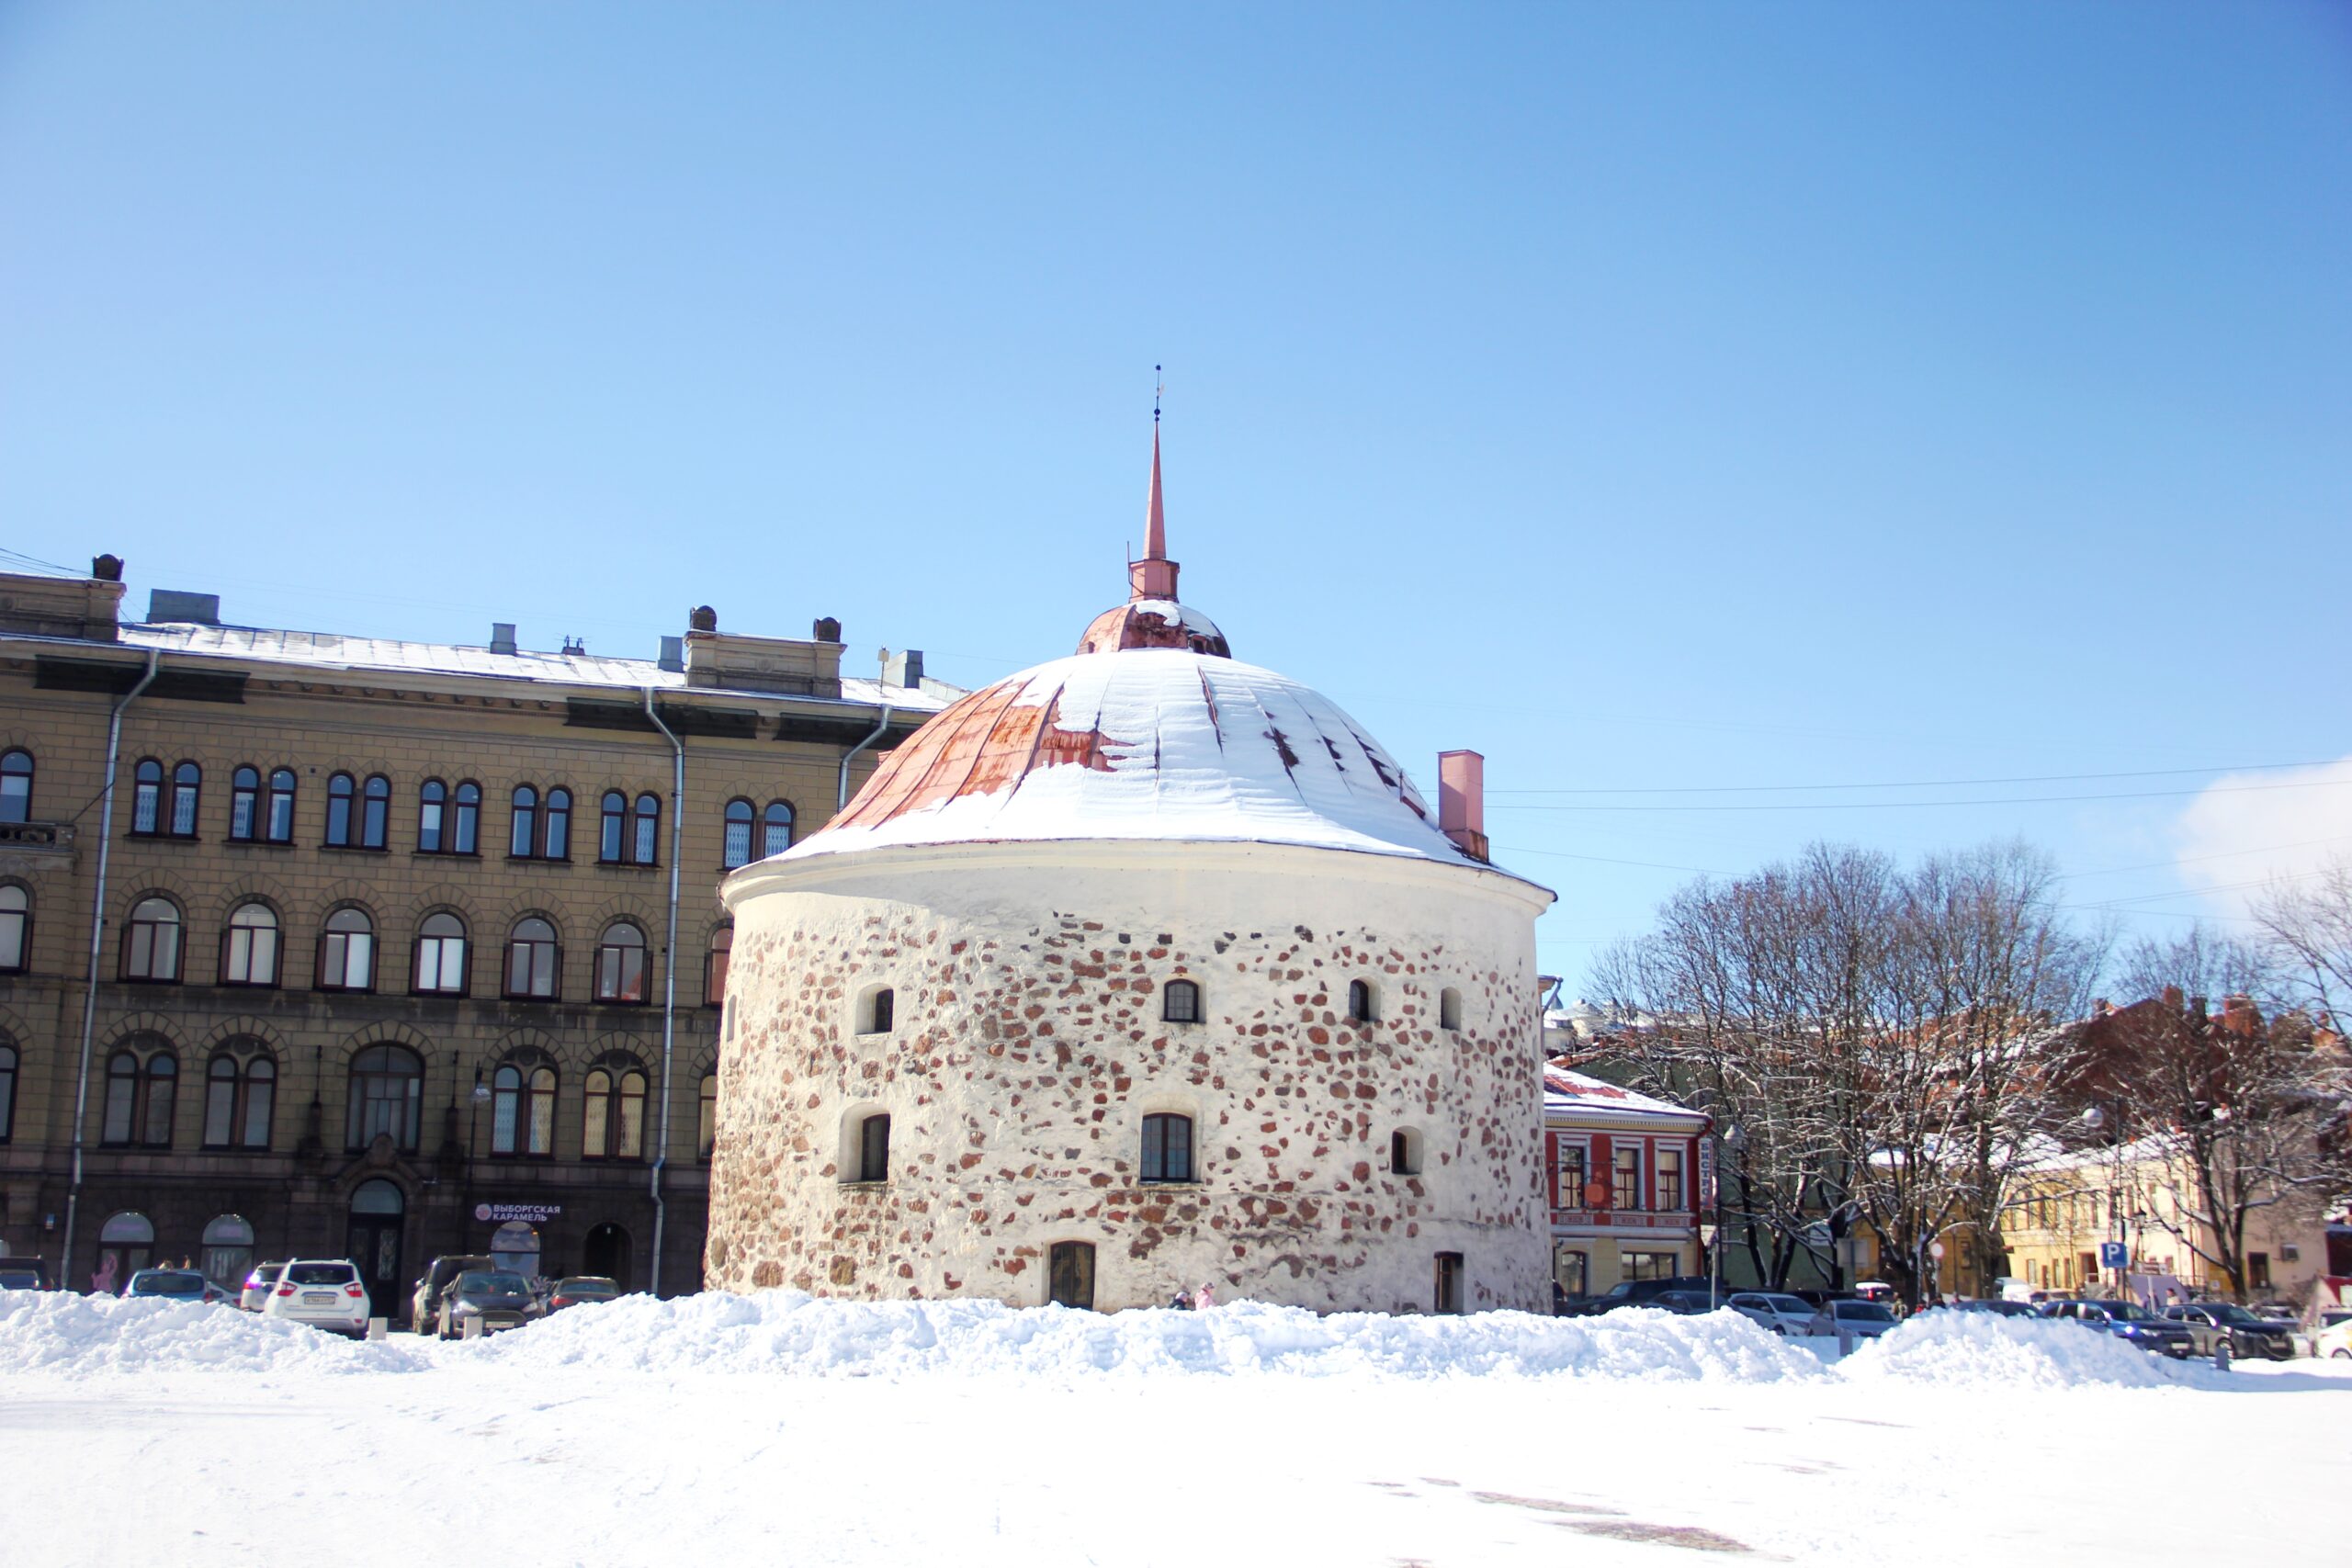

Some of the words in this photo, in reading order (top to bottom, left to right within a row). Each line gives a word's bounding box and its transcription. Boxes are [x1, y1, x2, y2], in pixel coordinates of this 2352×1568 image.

[1701, 1143, 1711, 1196] БИСТРО
[492, 1204, 560, 1213] ВЫБОРГСКАЯ
[492, 1213, 548, 1222] КАРАМЕЛЬ
[2107, 1244, 2120, 1261] P
